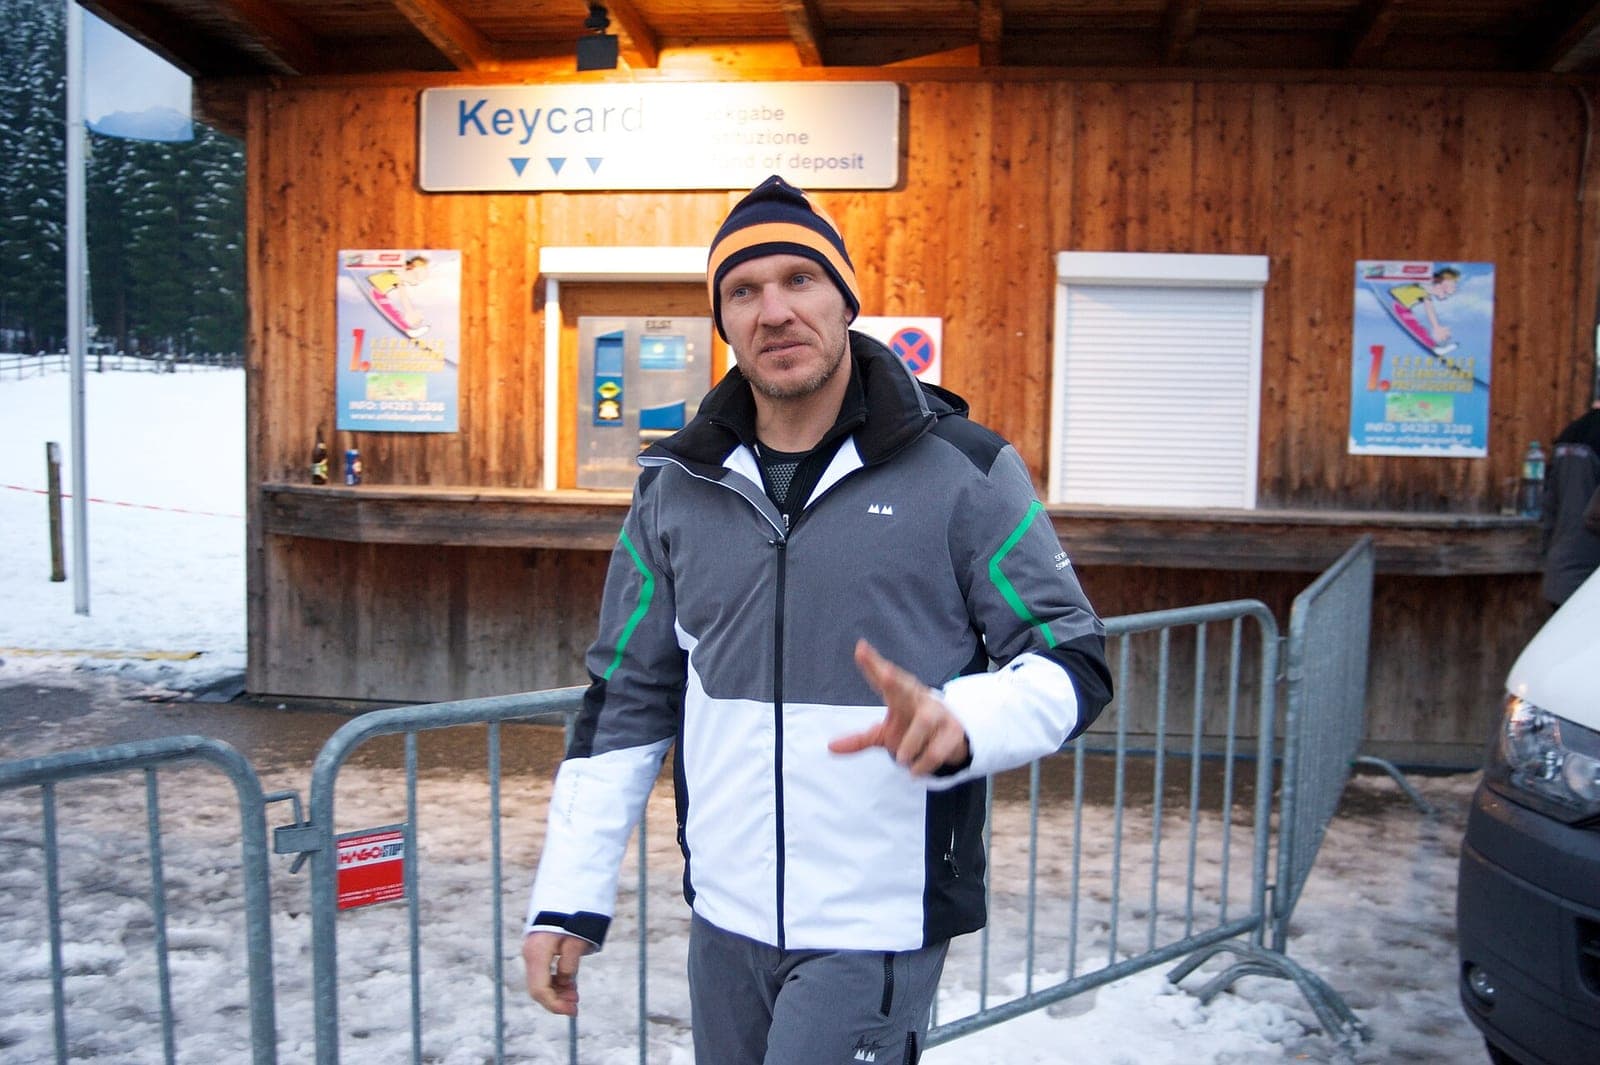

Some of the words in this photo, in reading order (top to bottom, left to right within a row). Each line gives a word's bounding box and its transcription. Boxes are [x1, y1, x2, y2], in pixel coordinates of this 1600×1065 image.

[457, 98, 644, 145] Keycard
[763, 152, 782, 170] of
[787, 152, 865, 175] deposit
